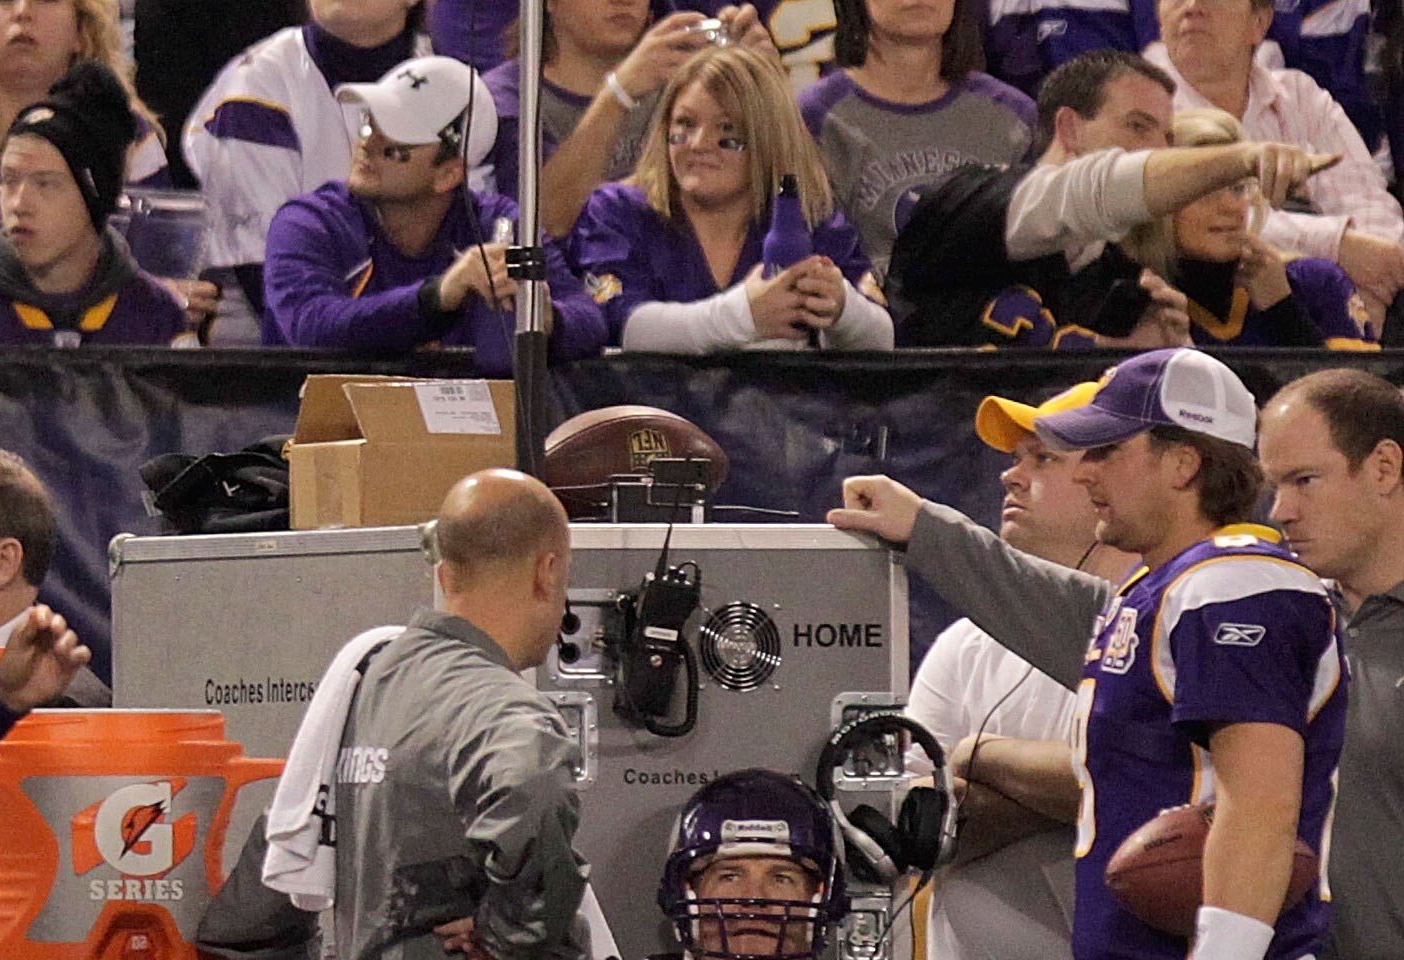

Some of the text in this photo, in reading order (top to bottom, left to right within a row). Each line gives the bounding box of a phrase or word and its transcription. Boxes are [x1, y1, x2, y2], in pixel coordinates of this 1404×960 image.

[793, 623, 883, 648] HOME
[204, 677, 265, 705] Coaches
[623, 767, 709, 785] Coaches
[95, 781, 174, 876] G
[89, 879, 184, 900] SERIES
